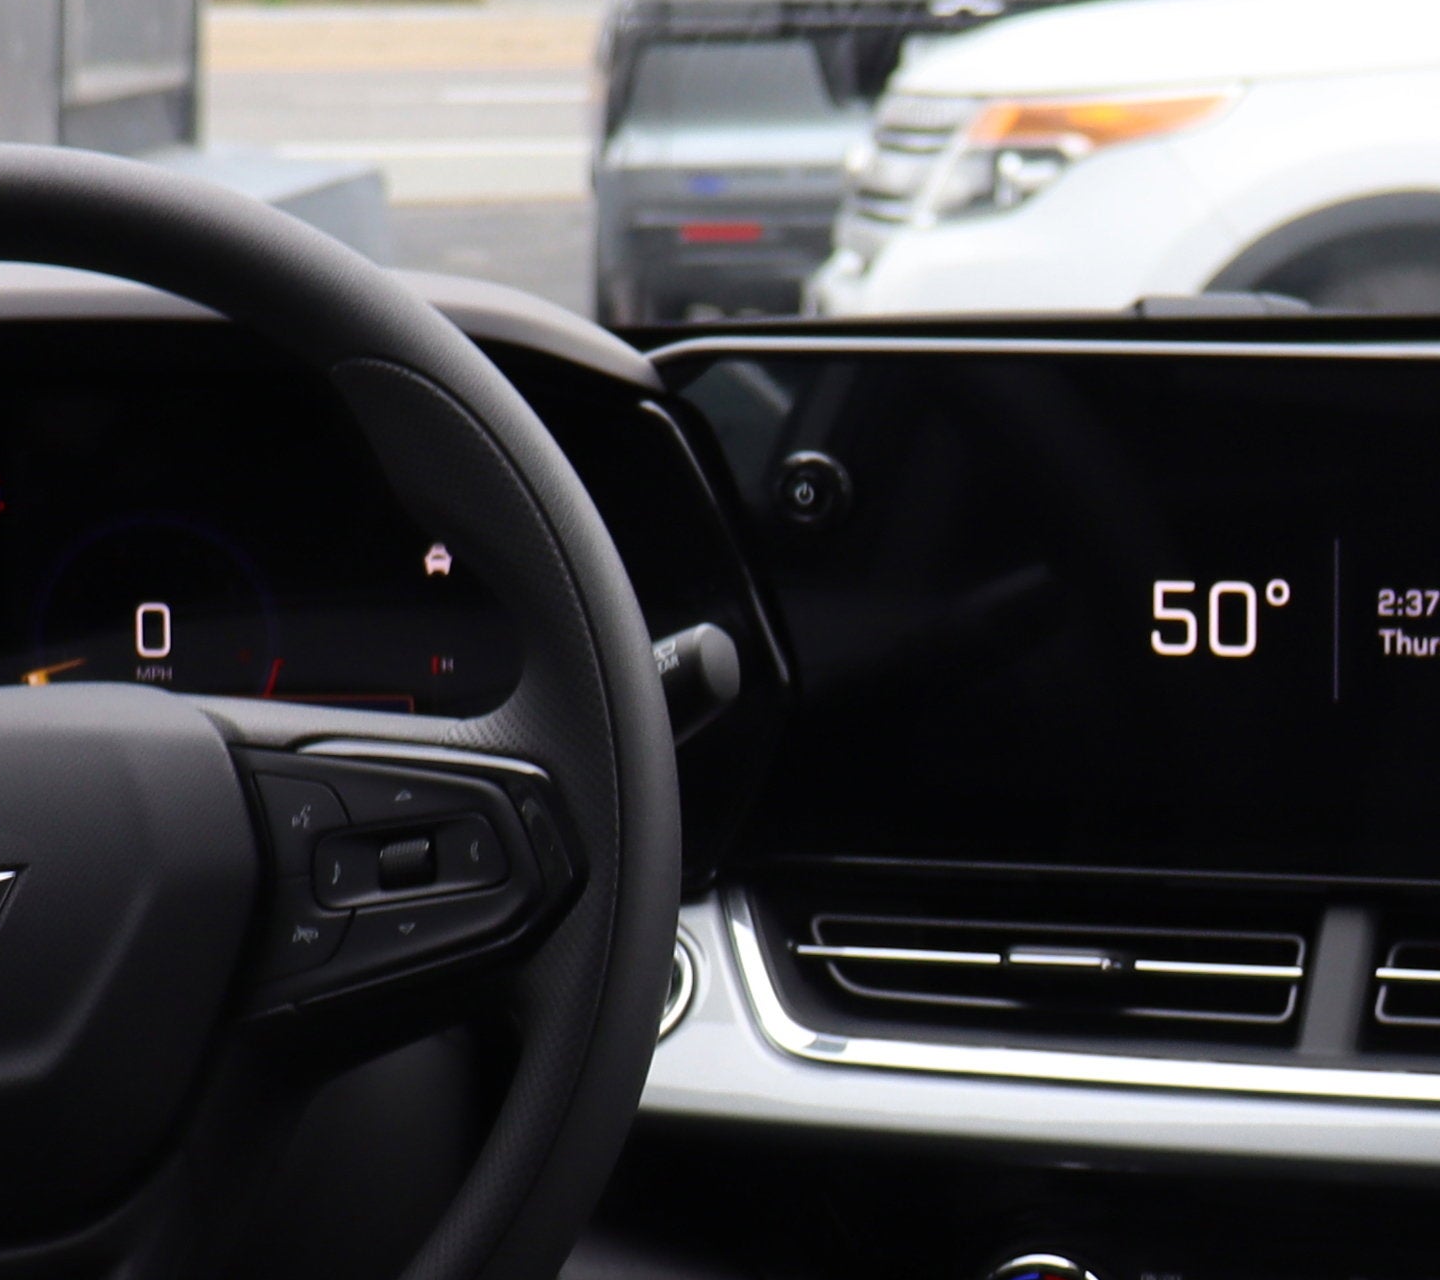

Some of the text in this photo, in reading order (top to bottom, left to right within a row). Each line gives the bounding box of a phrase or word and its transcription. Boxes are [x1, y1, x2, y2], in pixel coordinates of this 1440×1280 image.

[1151, 577, 1291, 659] 50°
[1376, 588, 1440, 618] 2:37
[134, 601, 172, 659] 0
[135, 665, 173, 682] MPH
